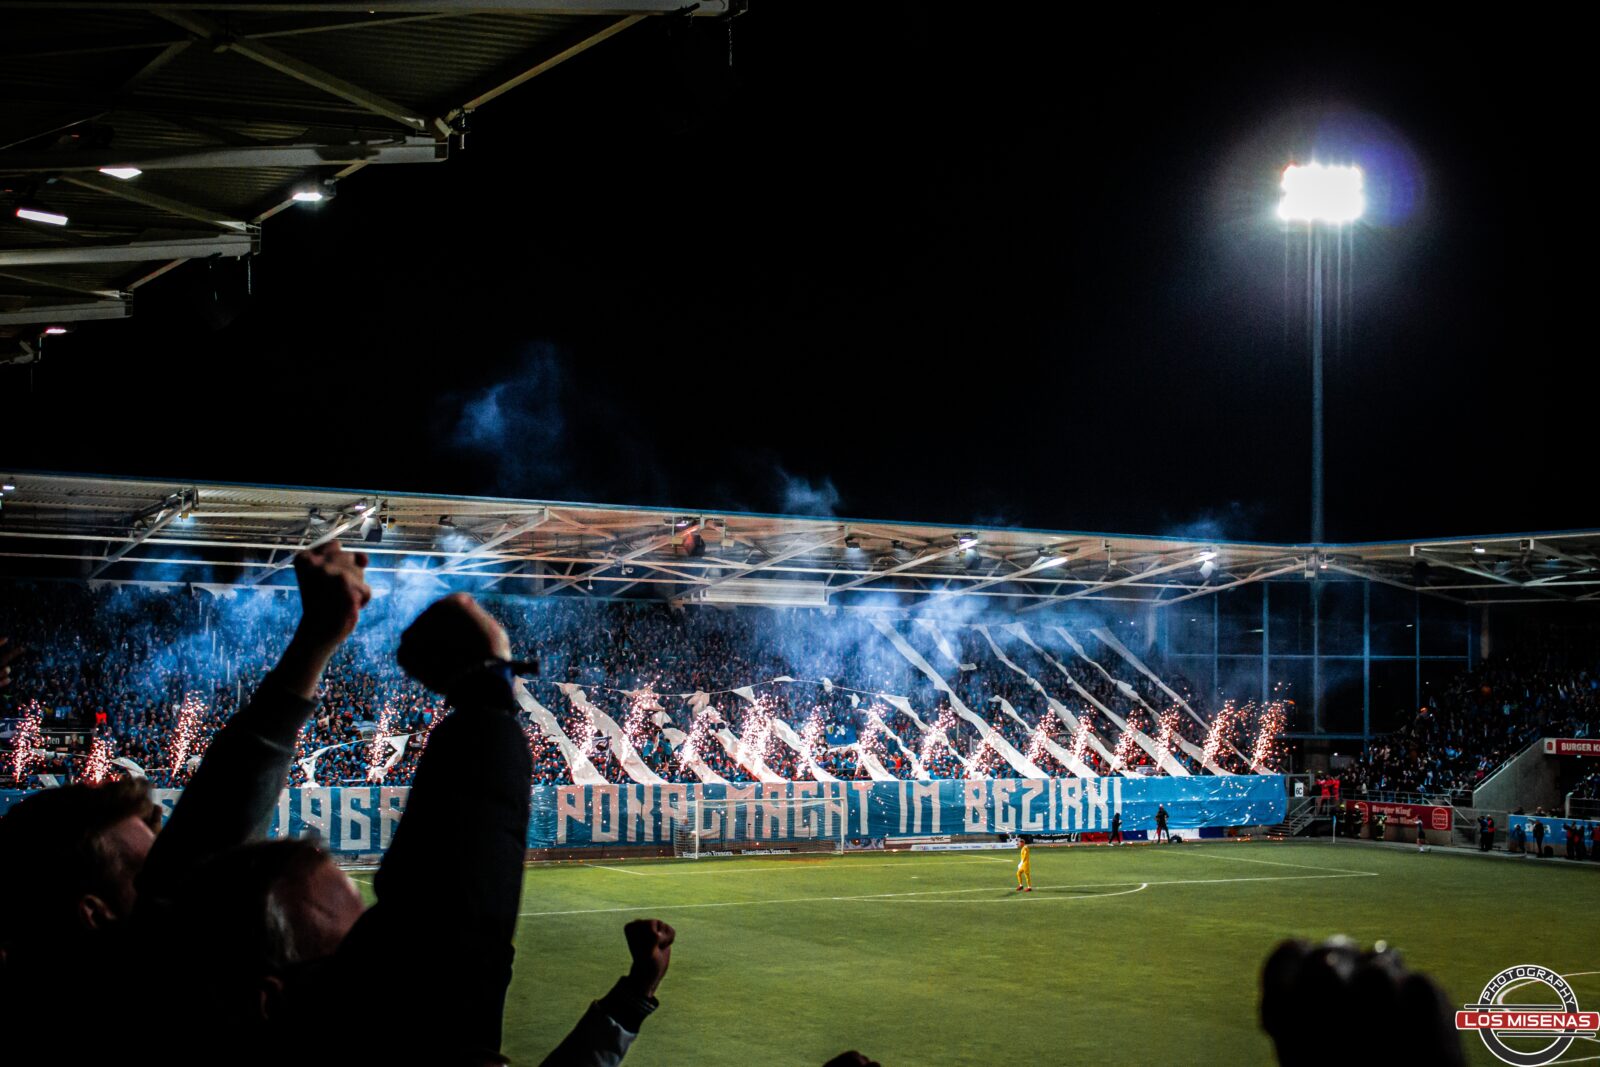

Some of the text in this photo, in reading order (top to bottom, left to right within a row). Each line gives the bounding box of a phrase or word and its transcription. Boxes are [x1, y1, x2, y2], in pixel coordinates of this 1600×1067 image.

[1561, 742, 1592, 752] BURGER
[556, 781, 873, 844] POKALMACHT
[899, 780, 941, 833] IM
